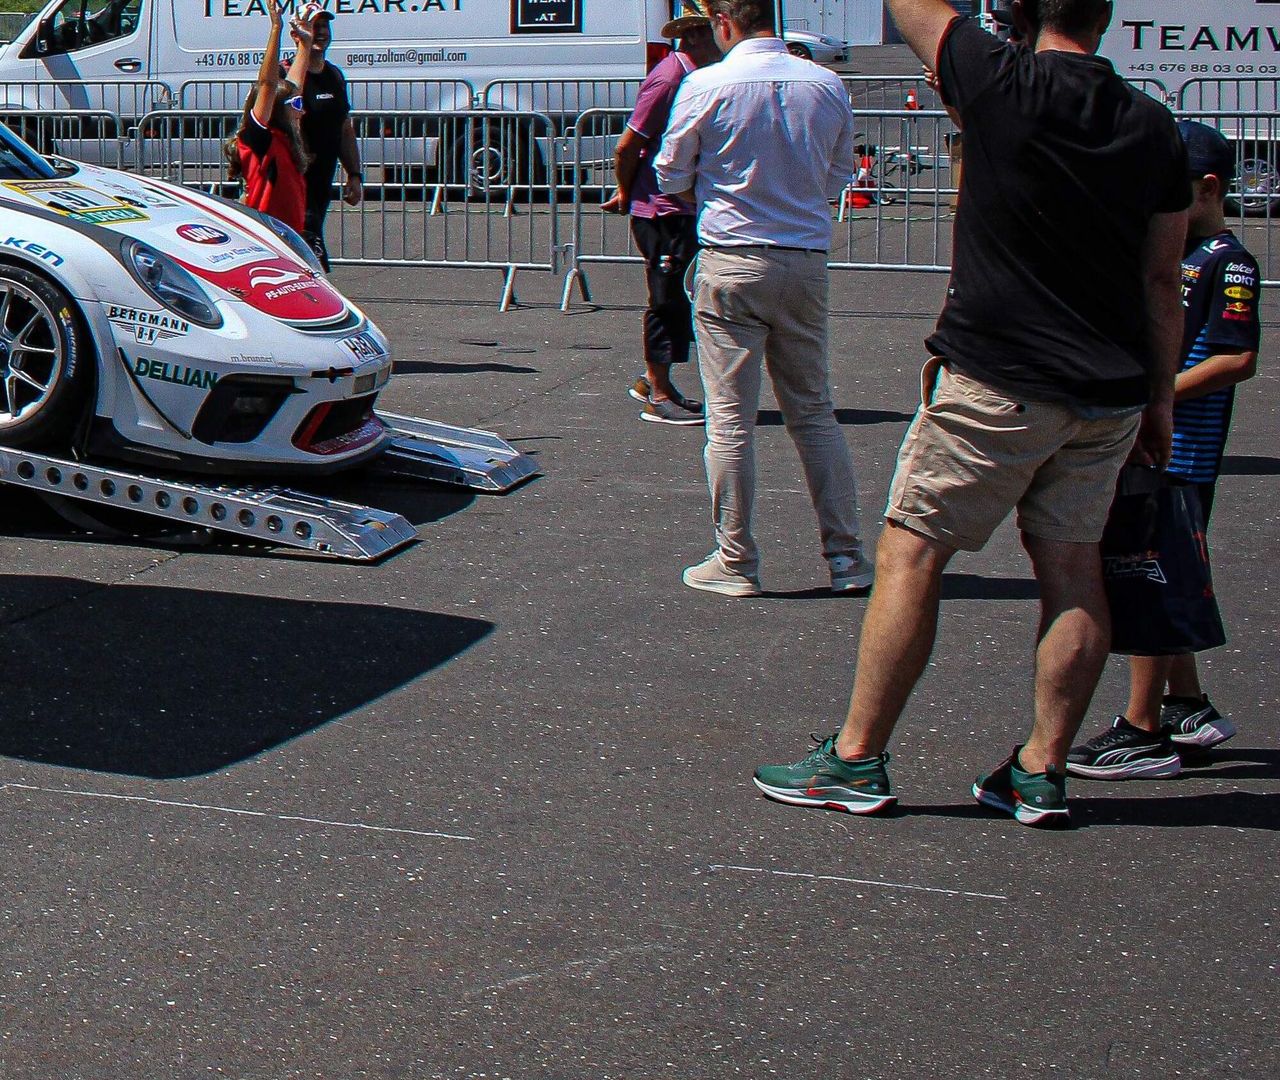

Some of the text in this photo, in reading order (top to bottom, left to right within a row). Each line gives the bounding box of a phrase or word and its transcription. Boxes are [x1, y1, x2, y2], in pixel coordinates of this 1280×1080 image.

[535, 13, 557, 22] .AT
[195, 53, 214, 66] +43
[217, 52, 235, 66] 676
[237, 52, 250, 65] 88
[346, 49, 467, 66] georg.zoltan@gmail.com
[1128, 64, 1277, 74] +43 676 88 03 03 03
[49, 190, 102, 208] 91
[1225, 261, 1255, 274] telcel
[1224, 273, 1255, 286] ROKT
[109, 306, 189, 332] BERGMANN
[134, 356, 219, 389] DELLIAN
